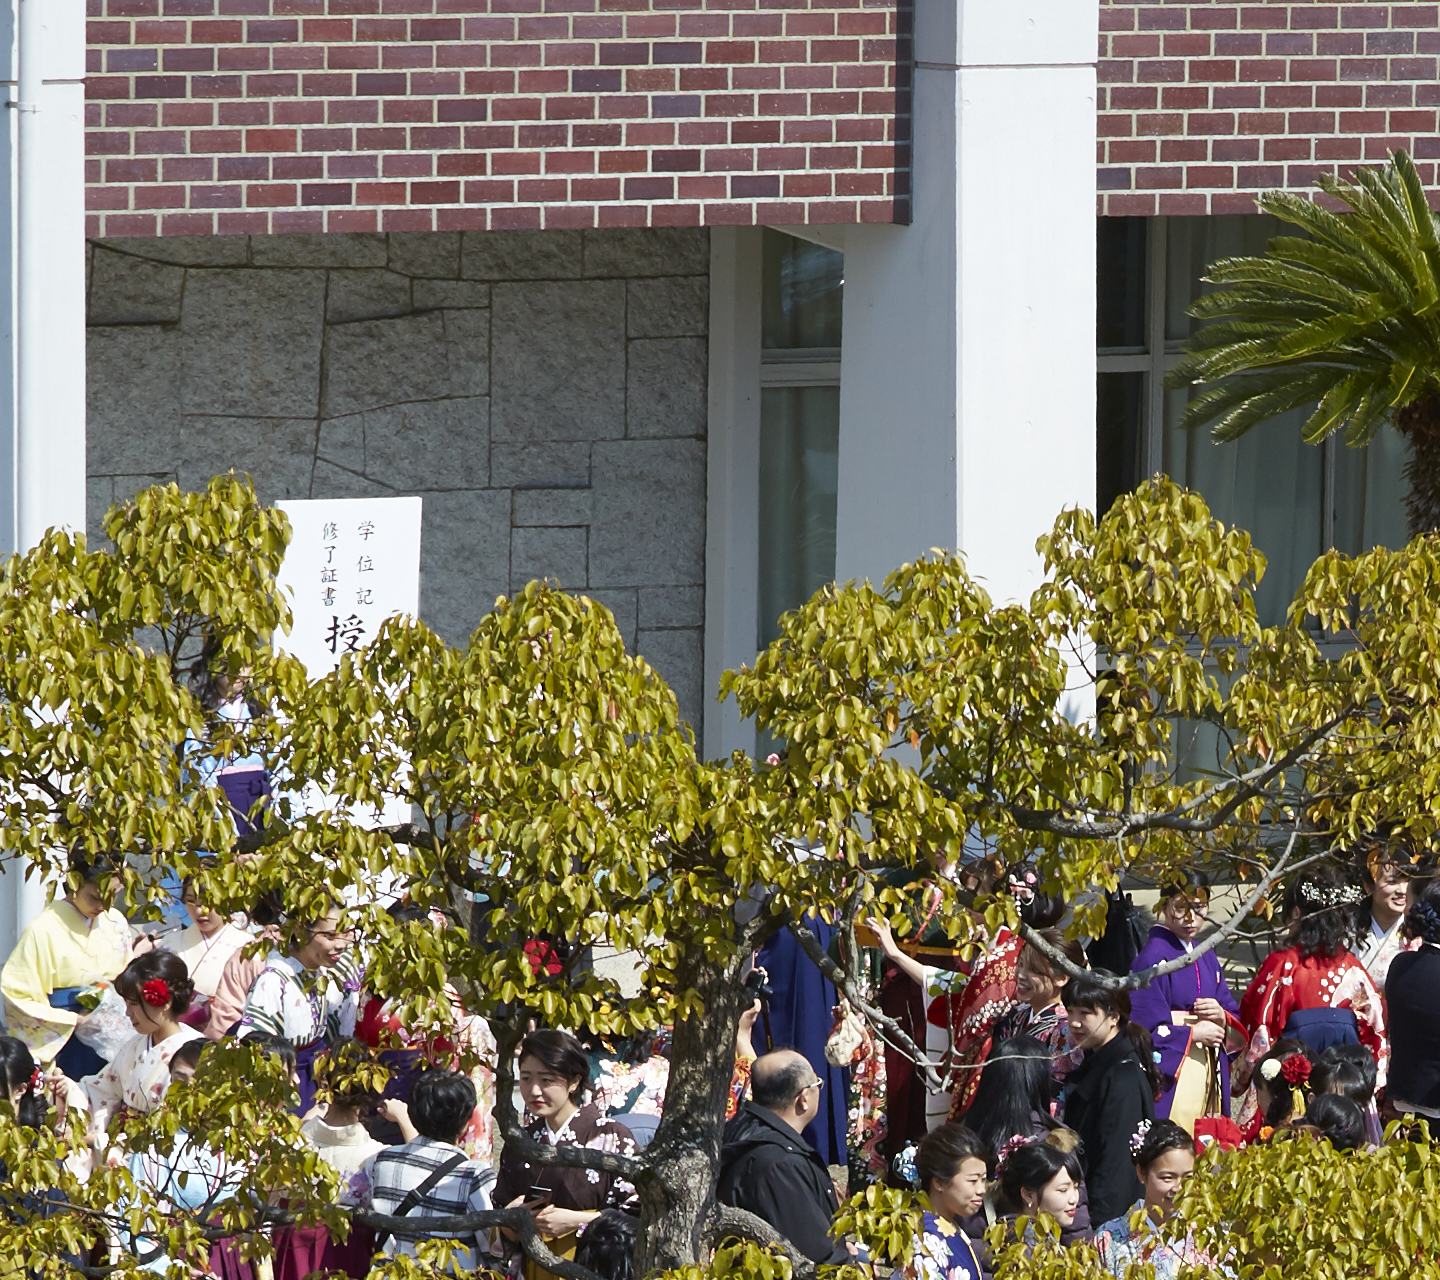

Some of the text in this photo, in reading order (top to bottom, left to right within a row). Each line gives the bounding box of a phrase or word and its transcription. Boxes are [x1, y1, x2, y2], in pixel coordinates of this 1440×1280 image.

[320, 521, 339, 606] 修了証書
[356, 520, 375, 605] 学位記
[324, 613, 366, 678] 授
